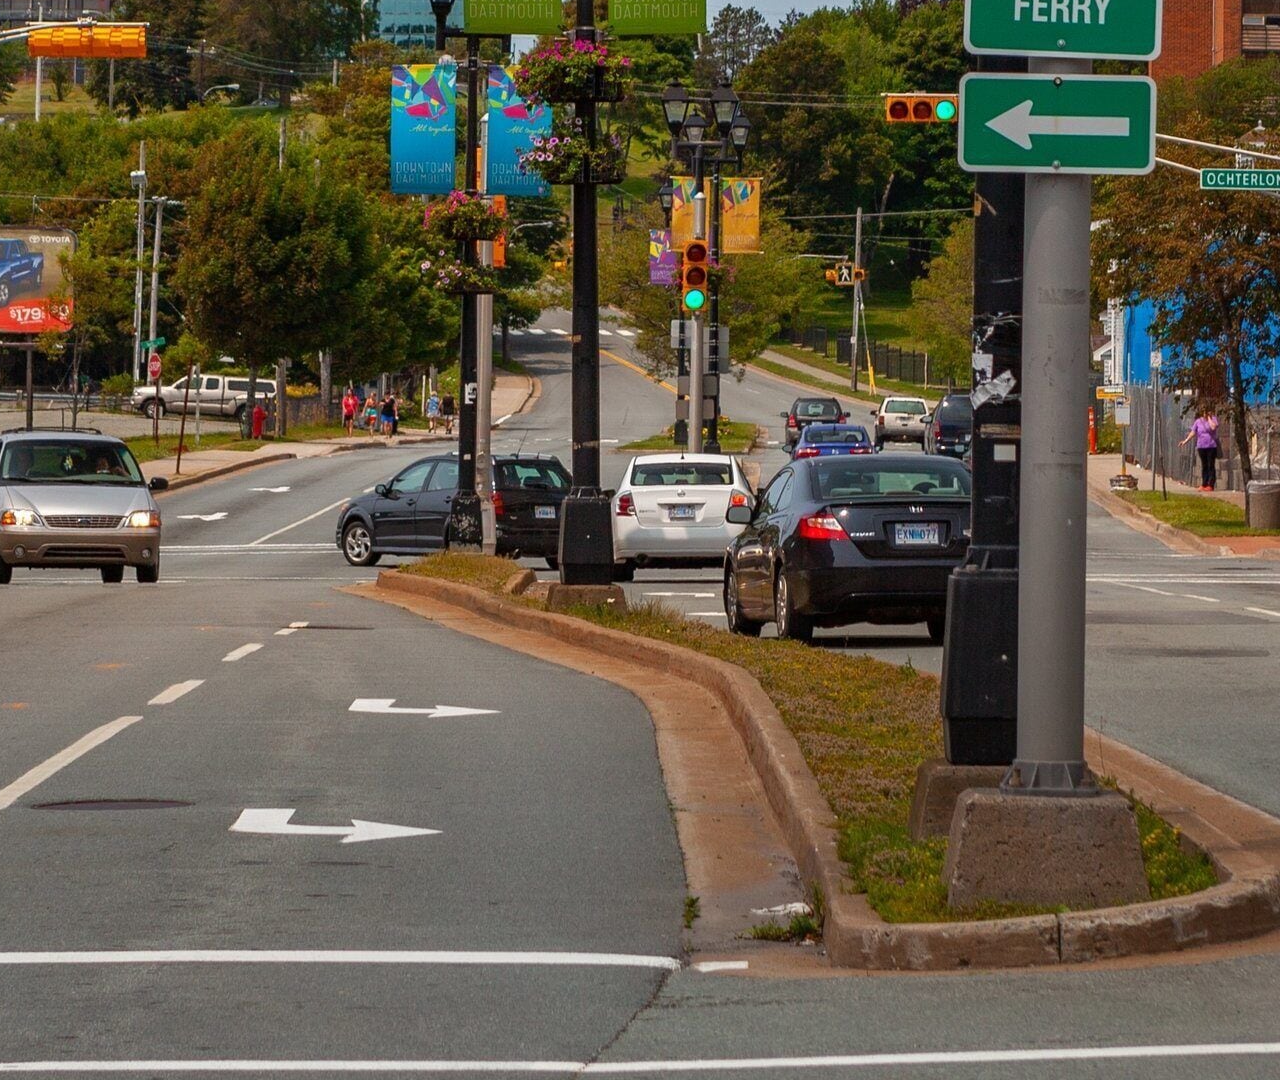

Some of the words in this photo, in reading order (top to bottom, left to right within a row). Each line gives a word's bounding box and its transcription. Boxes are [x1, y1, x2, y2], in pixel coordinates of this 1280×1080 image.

[469, 3, 554, 19] DARTMOUTH
[613, 3, 698, 19] DARTMOUTH
[395, 161, 452, 174] DOWNTOWN
[395, 174, 452, 184] DARTMOUTH
[41, 236, 71, 244] TOYOTA
[896, 528, 915, 540] EXN
[919, 528, 937, 540] 077
